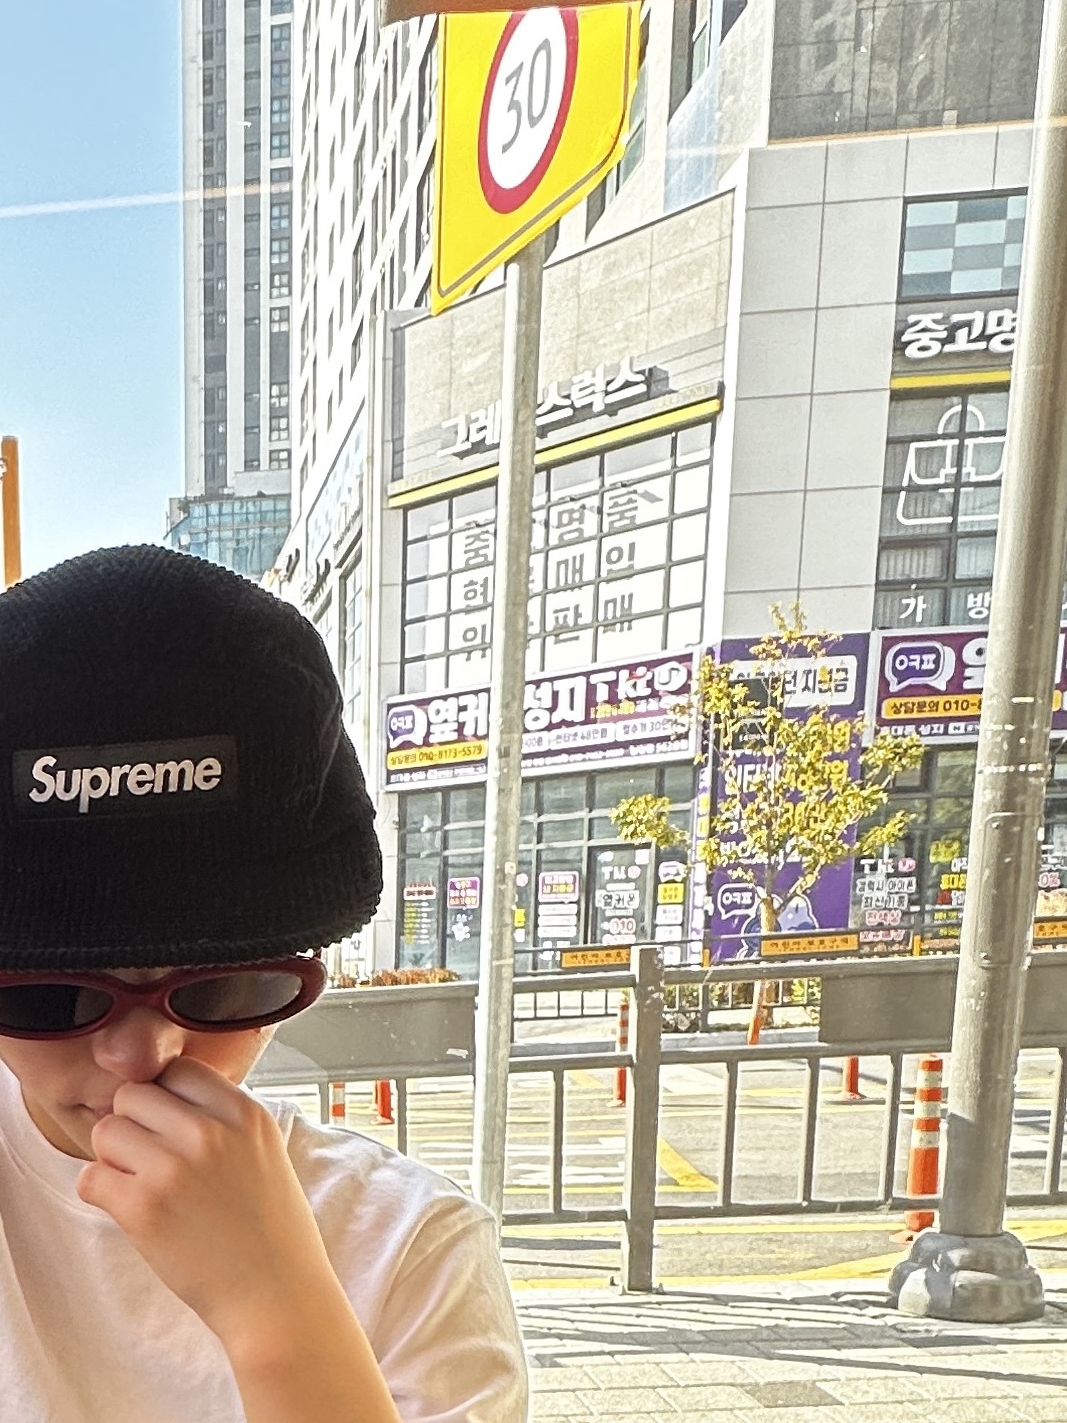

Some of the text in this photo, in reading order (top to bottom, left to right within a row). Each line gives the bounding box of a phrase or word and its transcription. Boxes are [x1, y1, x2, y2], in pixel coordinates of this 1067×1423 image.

[502, 37, 553, 156] 30
[437, 355, 651, 459] 그레스럭스
[428, 692, 490, 744] 옆커
[525, 676, 587, 732] 성지
[890, 701, 940, 716] 상담문의
[29, 755, 222, 814] Supreme
